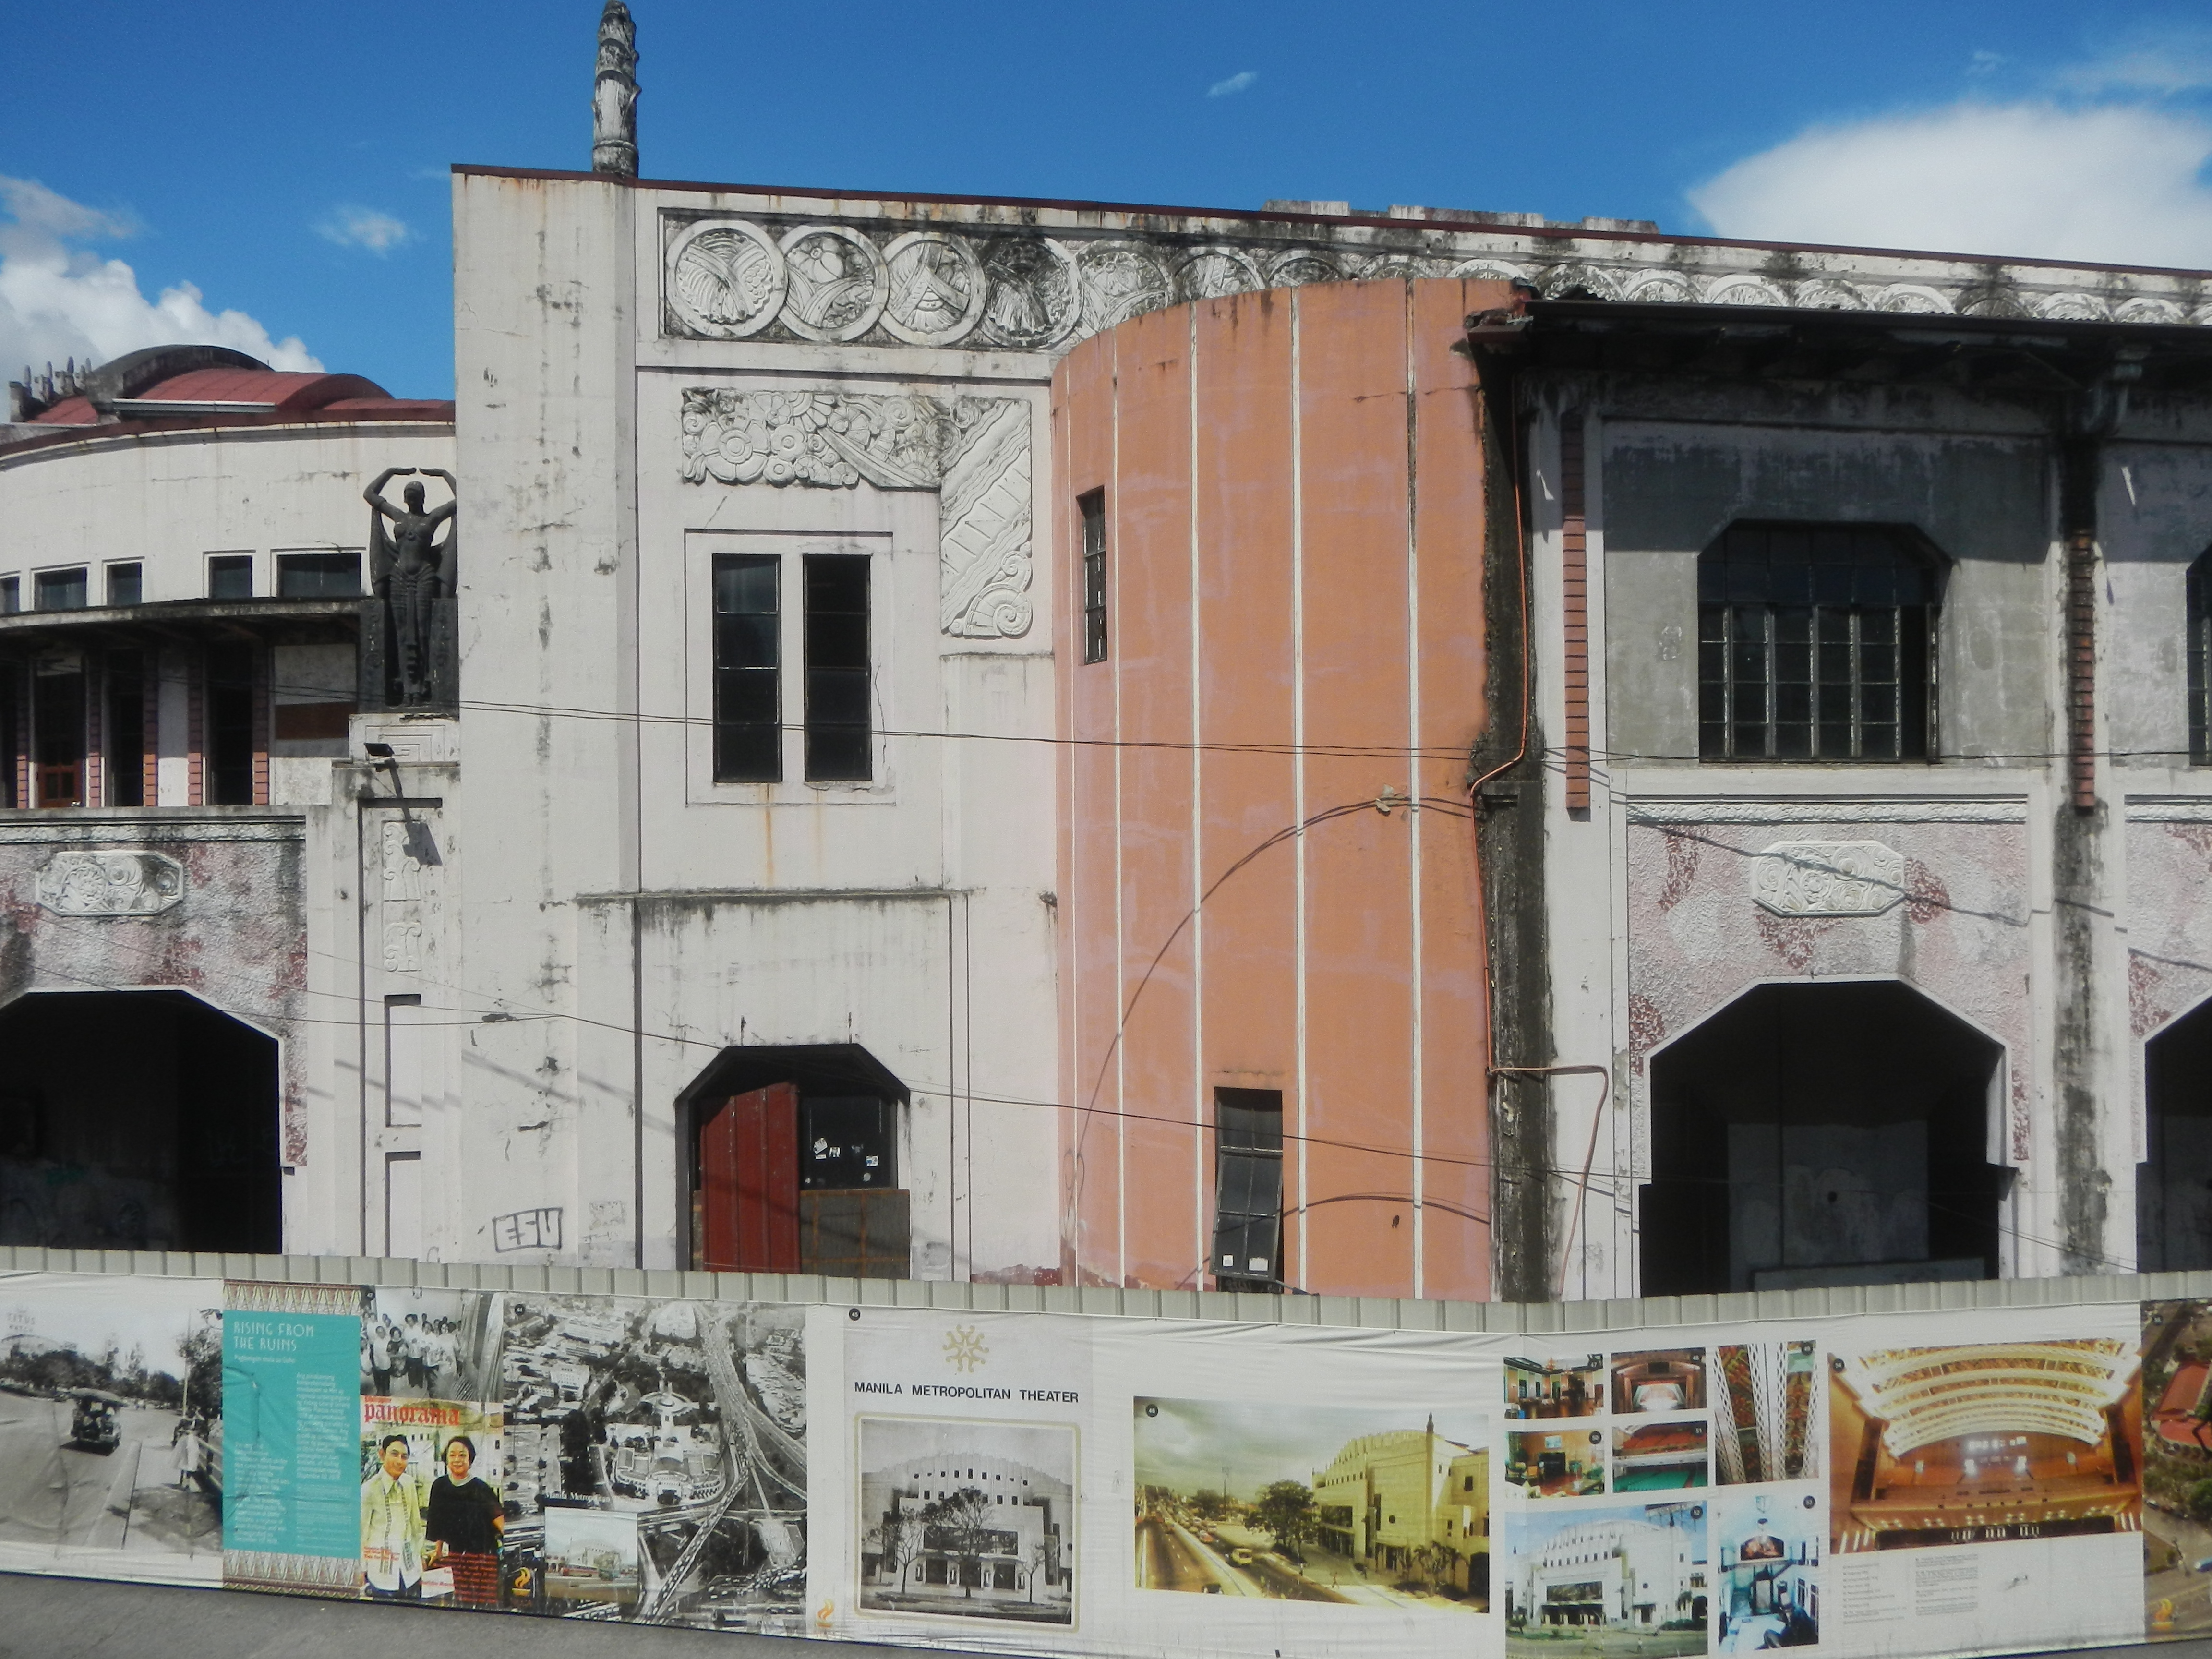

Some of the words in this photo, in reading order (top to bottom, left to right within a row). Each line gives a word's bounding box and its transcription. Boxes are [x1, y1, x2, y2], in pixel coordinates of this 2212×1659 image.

[233, 1321, 273, 1335] RISING
[278, 1323, 314, 1337] FROM
[233, 1336, 254, 1350] THE
[260, 1337, 297, 1351] RUINS
[854, 1381, 903, 1395] MANILA
[912, 1384, 1011, 1400] METROPOLITAN
[1019, 1389, 1079, 1403] THEATER
[364, 1404, 460, 1426] panorama
[544, 1491, 567, 1500] Manila
